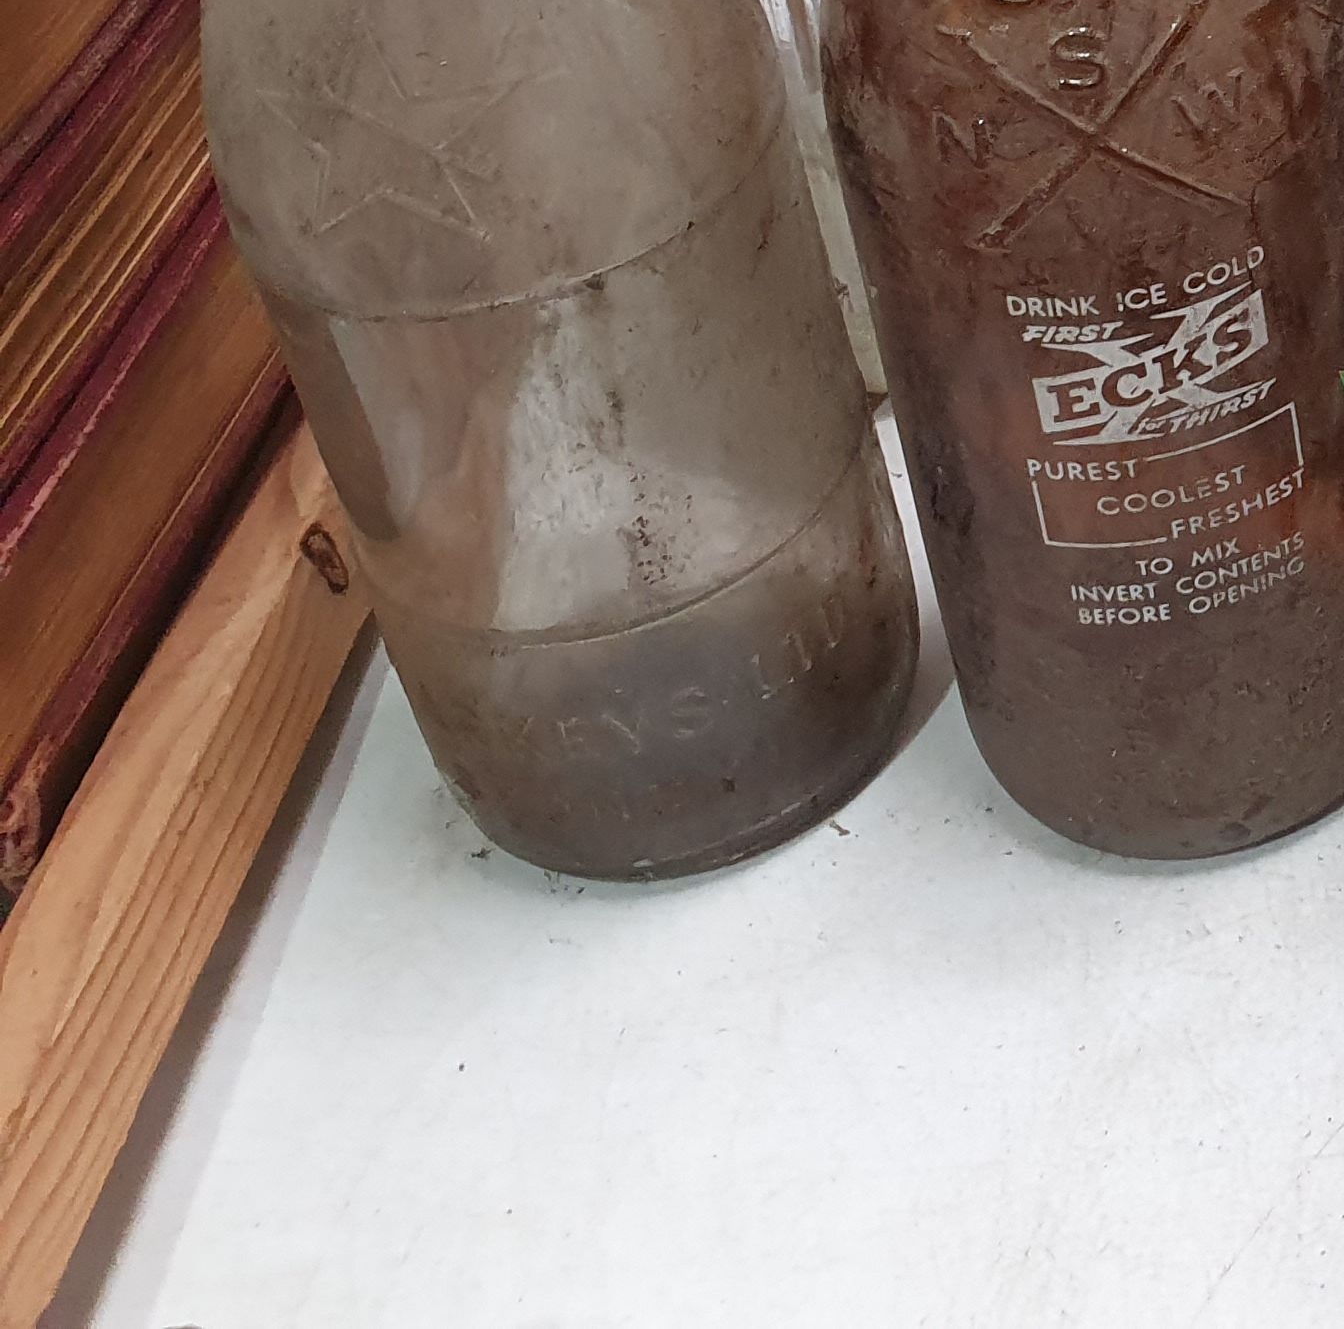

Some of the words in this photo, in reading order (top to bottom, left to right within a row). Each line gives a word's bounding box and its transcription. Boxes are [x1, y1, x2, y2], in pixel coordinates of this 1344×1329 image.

[1005, 294, 1100, 318] DRINK
[1116, 282, 1168, 312] ICE
[1182, 245, 1266, 295] COLD
[1021, 321, 1125, 343] FIRST
[1044, 302, 1264, 426] ECKS
[1135, 417, 1166, 435] for
[1168, 377, 1278, 435] THIRST
[1026, 457, 1139, 482] PUREST
[1096, 464, 1248, 516] COOLEST
[1170, 469, 1305, 540] FRESHEST
[1070, 582, 1158, 603] INVERT
[1175, 531, 1306, 596] CONTENTS
[1135, 556, 1175, 577] TO
[1190, 536, 1243, 568] MIX
[1077, 604, 1173, 626] BEFORE
[1188, 558, 1306, 615] OPENING
